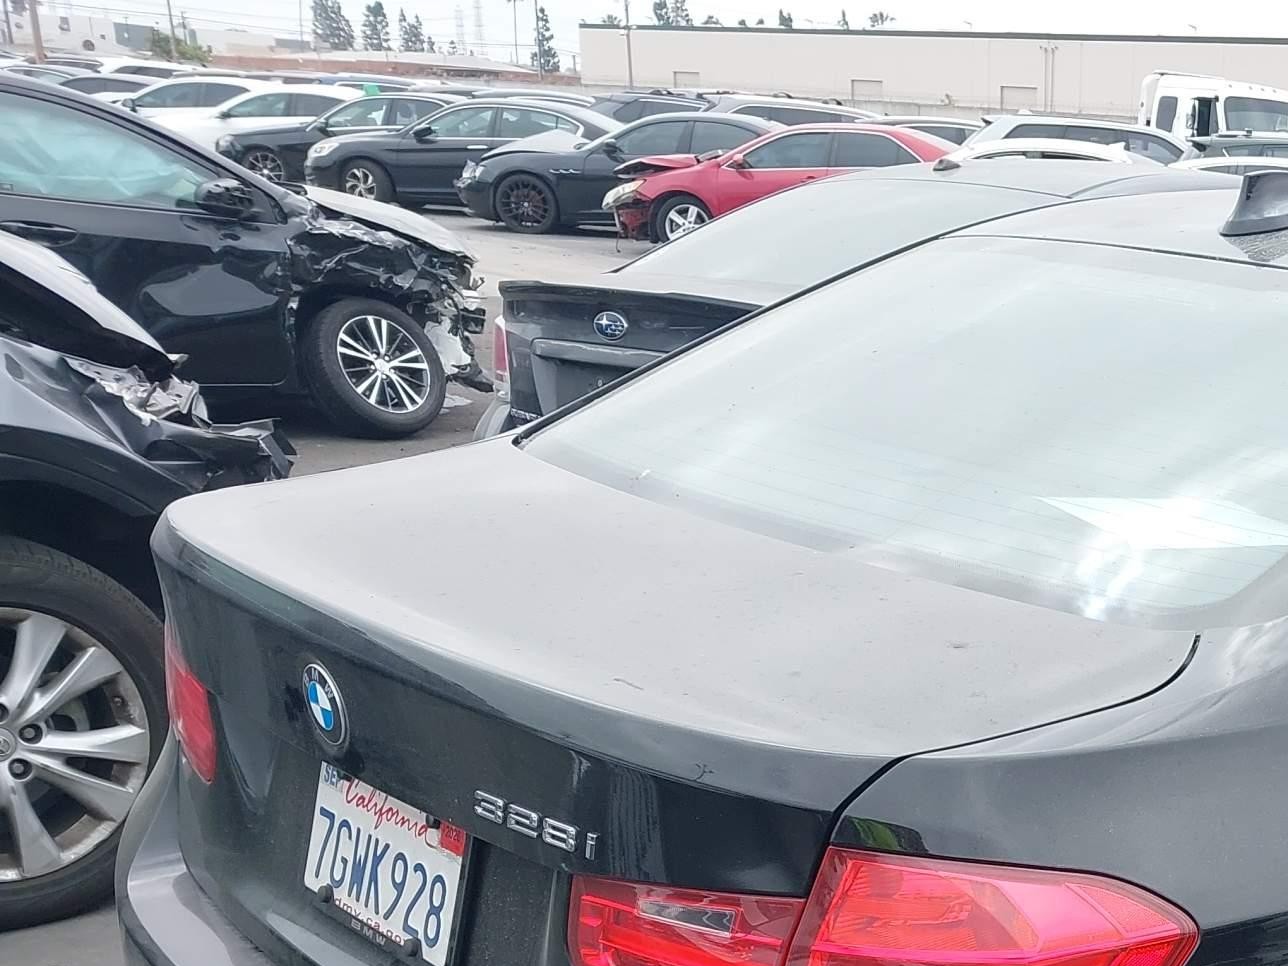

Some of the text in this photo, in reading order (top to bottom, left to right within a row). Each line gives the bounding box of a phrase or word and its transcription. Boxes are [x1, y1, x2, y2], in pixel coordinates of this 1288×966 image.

[304, 668, 334, 699] BMW
[344, 779, 431, 842] California
[473, 789, 600, 861] 328i
[315, 806, 447, 949] 7GWK928
